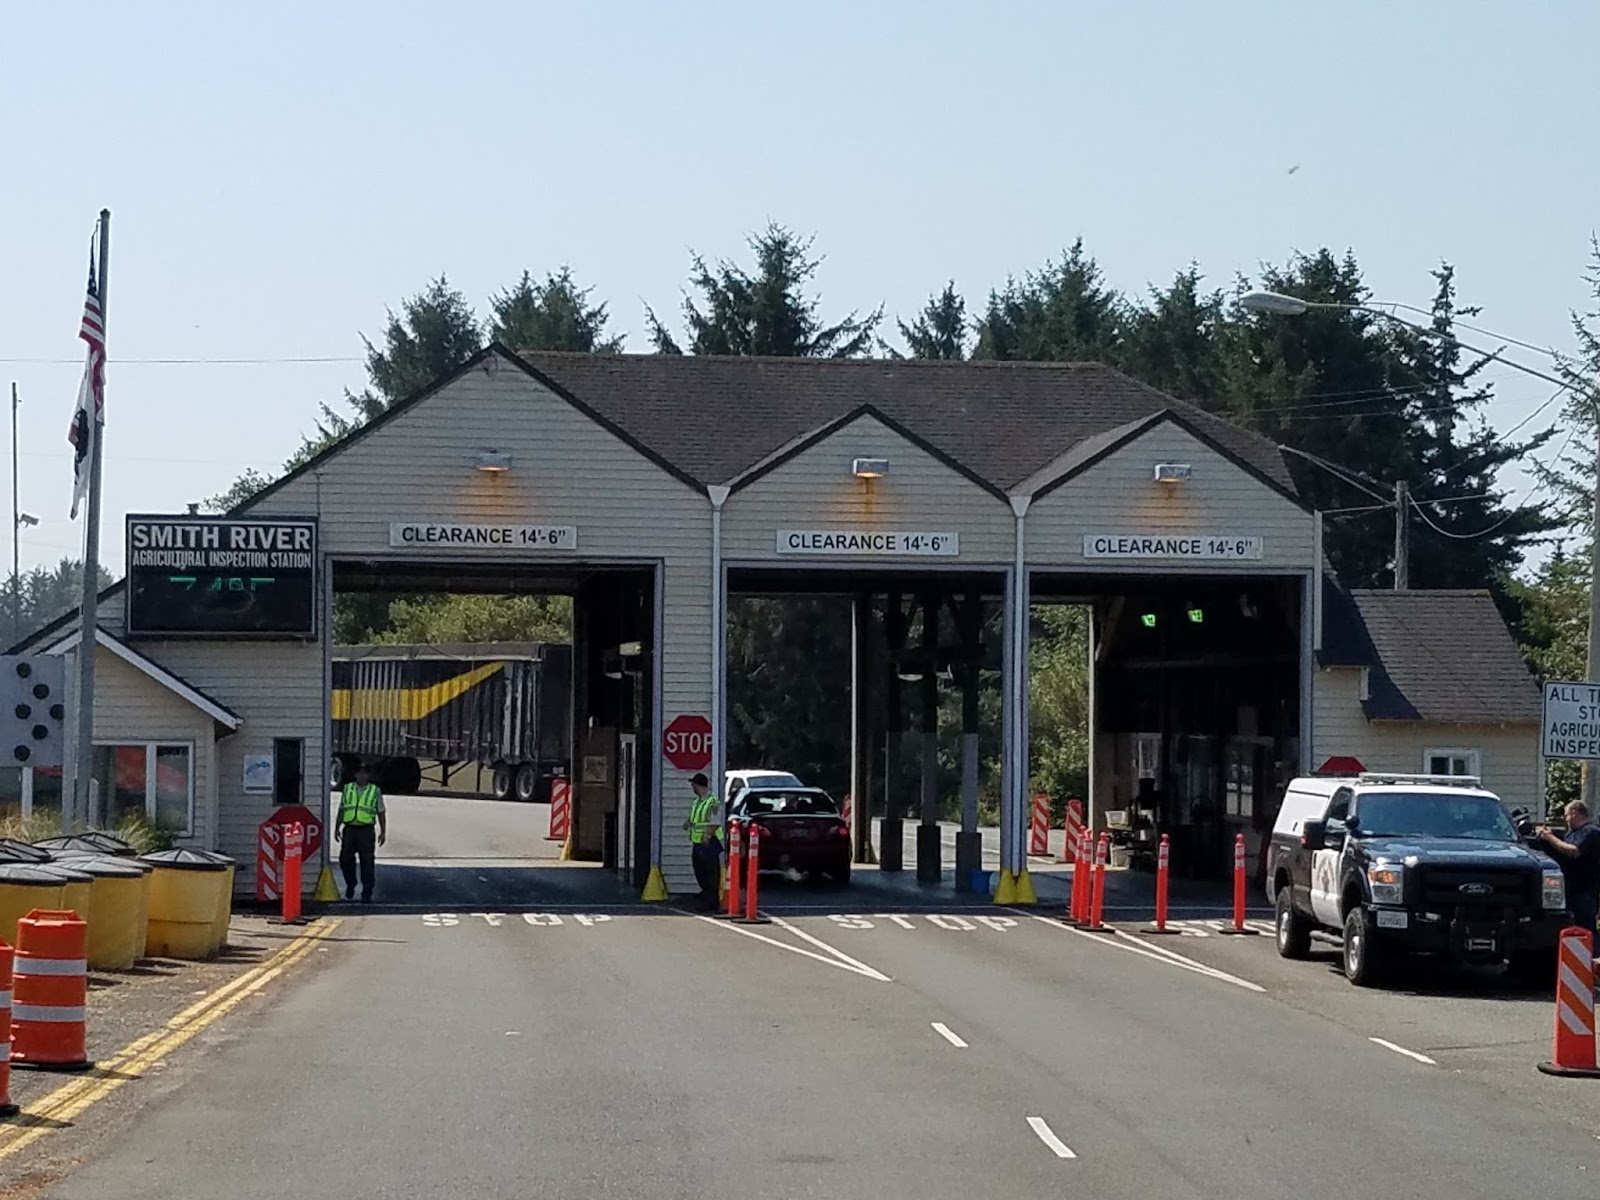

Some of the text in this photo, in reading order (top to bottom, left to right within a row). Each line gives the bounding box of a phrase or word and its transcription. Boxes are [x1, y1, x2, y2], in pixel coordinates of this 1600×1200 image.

[133, 525, 310, 550] SMITH RIVER
[402, 526, 513, 544] CLEARANCE
[788, 534, 896, 550] CLEARANCE
[1094, 538, 1201, 554] CLEARANCE
[133, 549, 311, 568] AGRICULTURAL INSPECTION STATION
[1549, 686, 1600, 703] ALL T
[1550, 721, 1600, 738] AGRICU
[1550, 739, 1600, 755] INSPE
[422, 913, 612, 927] STOP
[826, 913, 1018, 932] STOP
